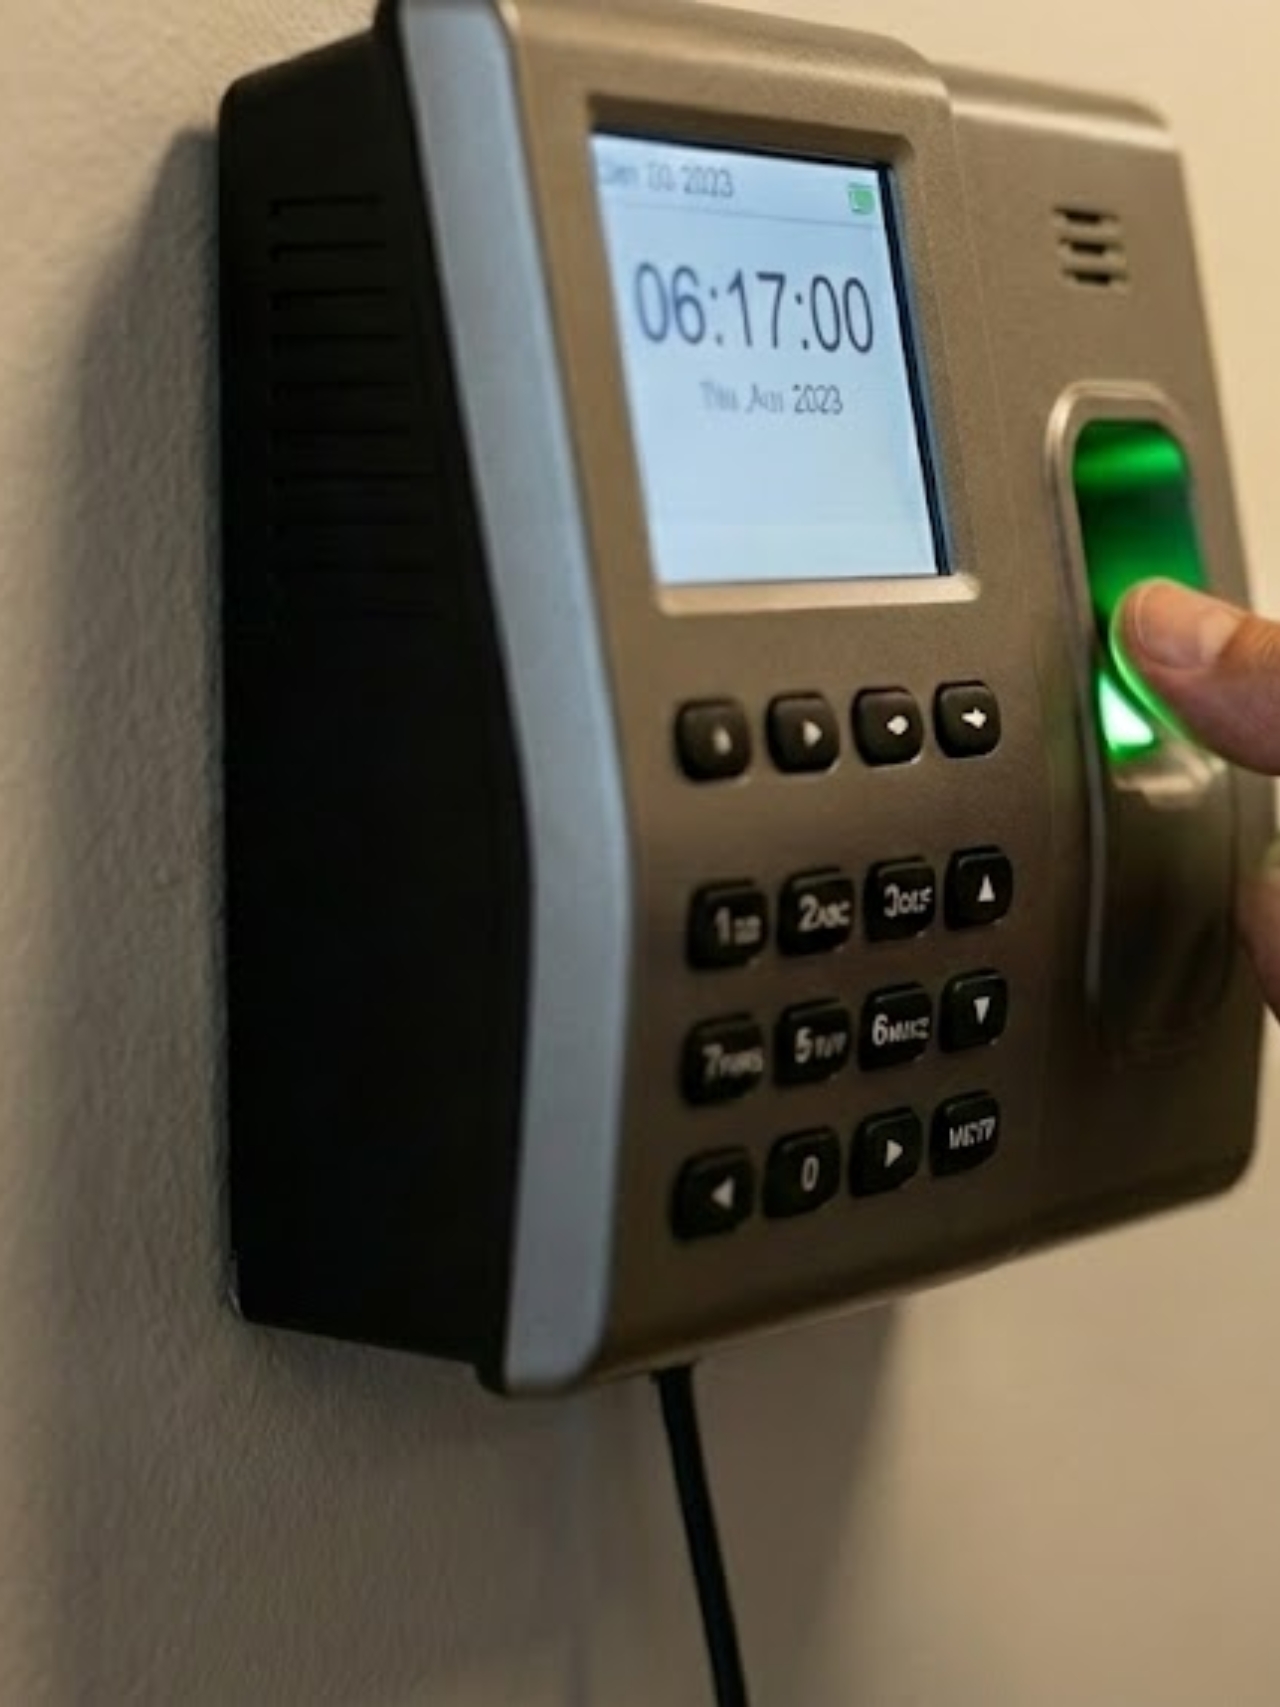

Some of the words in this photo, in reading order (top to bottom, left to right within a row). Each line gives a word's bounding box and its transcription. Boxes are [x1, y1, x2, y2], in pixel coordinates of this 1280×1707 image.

[634, 262, 875, 354] 06:17:00
[792, 382, 844, 416] 2023
[802, 1155, 820, 1193] 0
